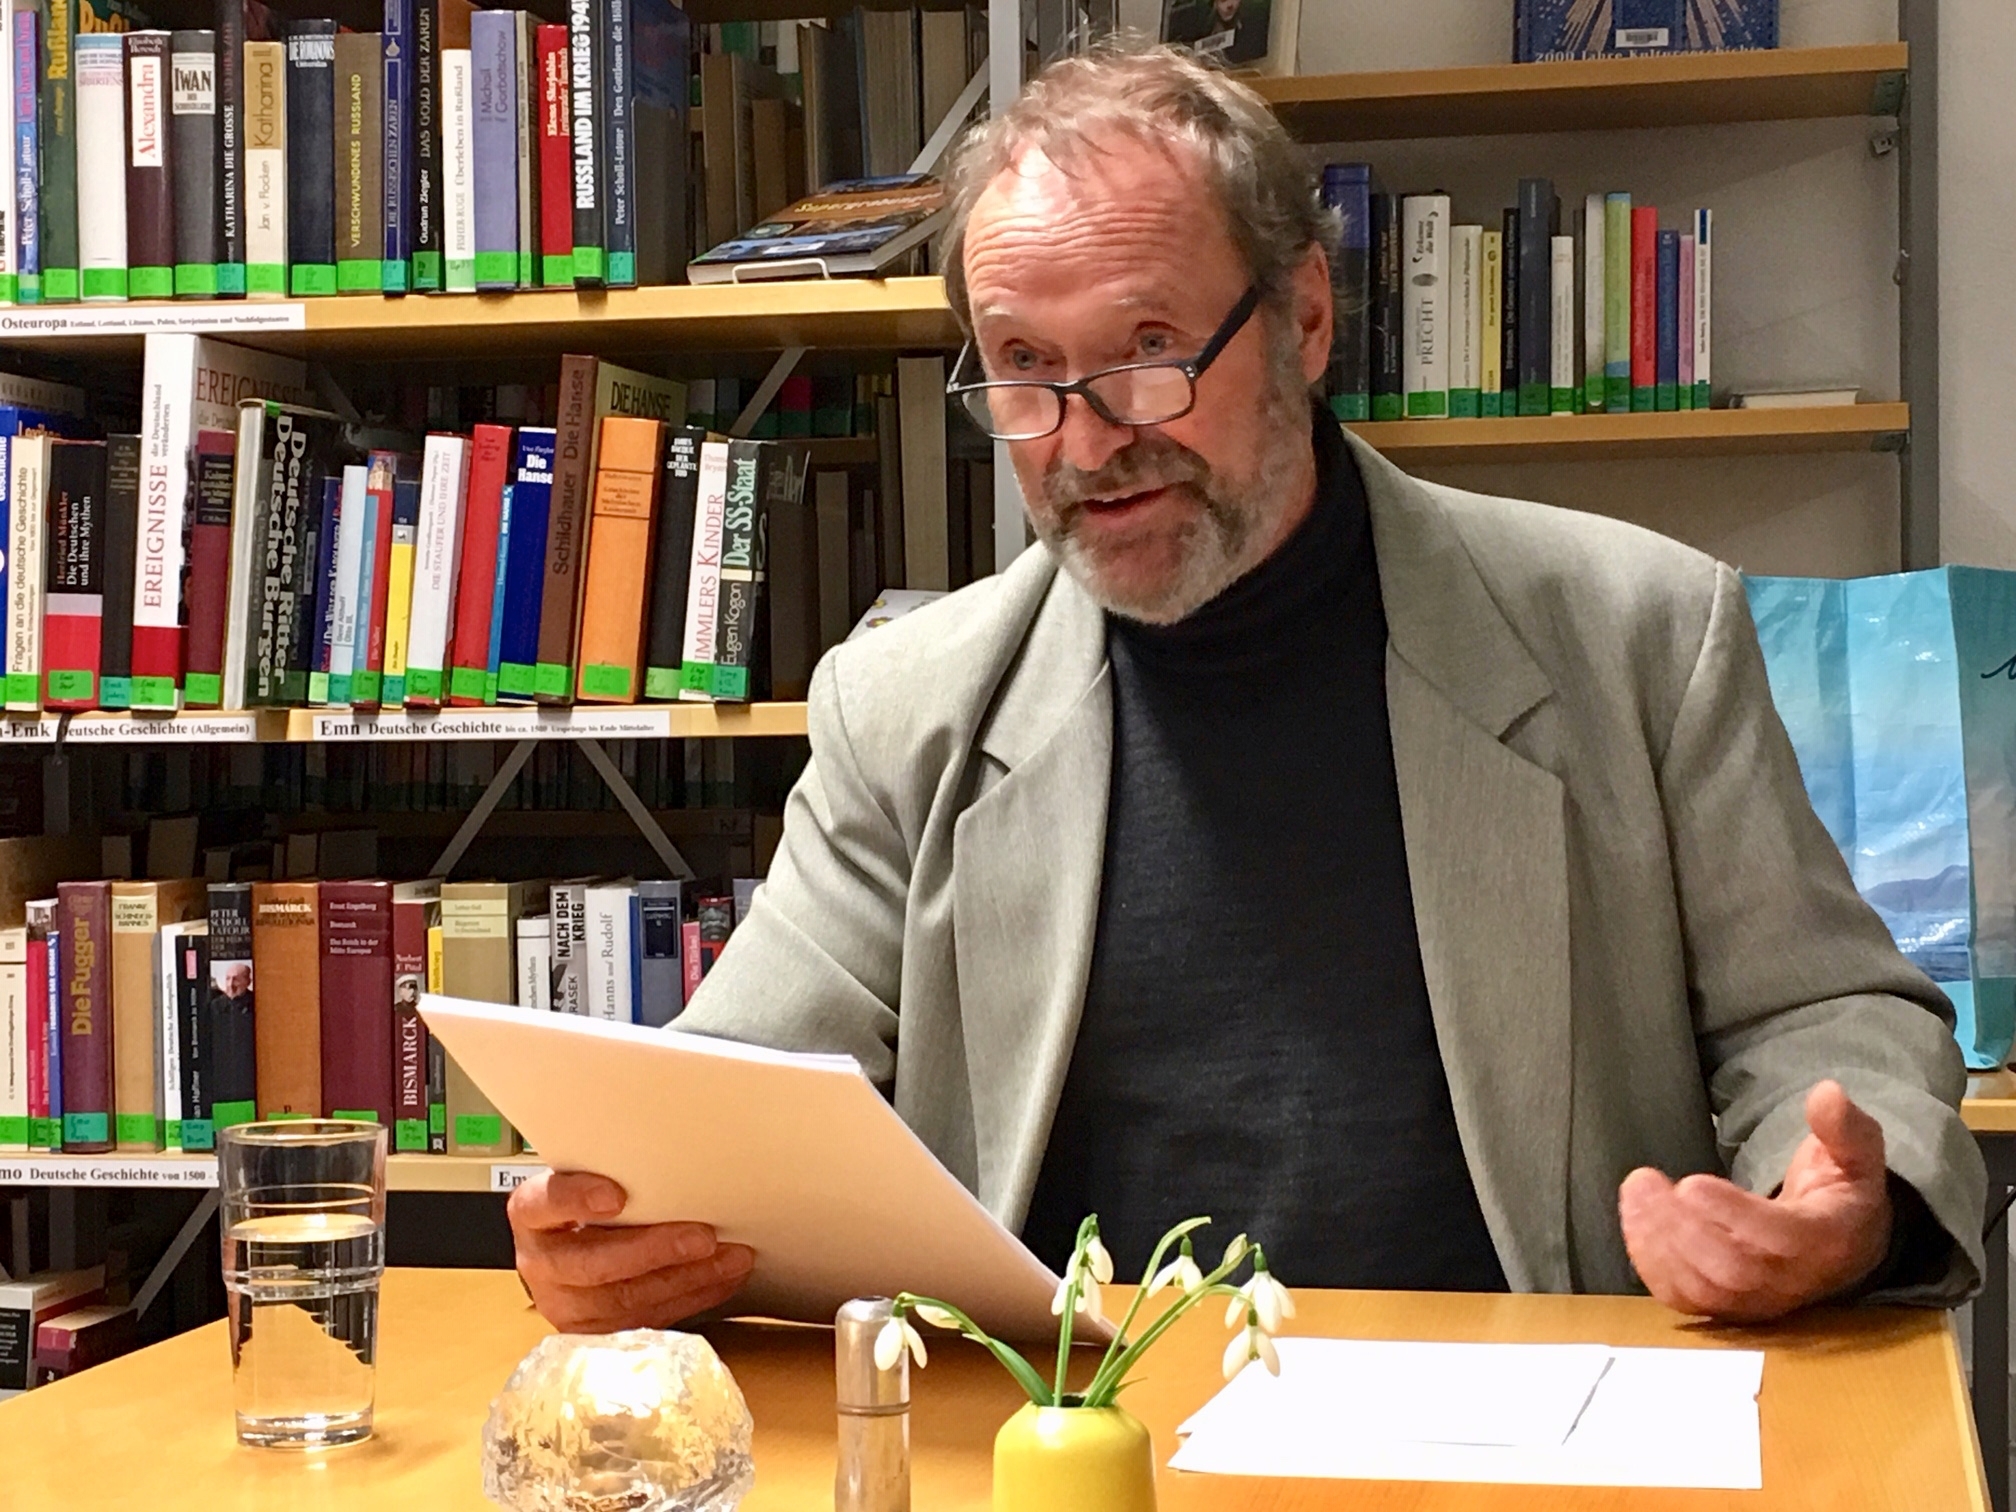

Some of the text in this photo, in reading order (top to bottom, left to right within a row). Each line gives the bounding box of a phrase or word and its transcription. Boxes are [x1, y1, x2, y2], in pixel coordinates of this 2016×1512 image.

[174, 68, 212, 92] IWAN
[419, 7, 431, 158] DAS GOLD DER ZAREN
[494, 31, 509, 114] Gorbatschow
[1535, 50, 1576, 63] 2000
[224, 105, 235, 147] GROSSE
[252, 62, 274, 147] Katharina
[454, 115, 463, 126] in
[572, 33, 595, 209] RUSSLAND IM KRIEG
[612, 25, 626, 225] Peter Scholl-Latour Den Gottlosen die
[20, 135, 33, 245] Peter Scholl-Latour
[224, 151, 235, 169] DIE
[351, 74, 362, 248] VERSCHWUNDENES RUSSLAND
[224, 172, 236, 238] KATHARINA
[257, 160, 271, 231] Jan Flocken
[418, 169, 430, 244] Gudrun Ziegler
[2, 317, 68, 331] Osteuropa
[1421, 297, 1434, 365] PRECHT
[151, 443, 160, 458] die
[441, 451, 451, 475] ZEIT
[518, 469, 554, 485] Hanse
[526, 454, 547, 469] Die
[553, 369, 584, 576] Schildhauer Die Hanse
[66, 502, 79, 586] Die Deutschen
[79, 496, 94, 586] und ihre Mythen
[143, 464, 168, 609] EREIGNISSE
[436, 501, 446, 525] UND
[696, 493, 724, 568] KINDER
[12, 466, 29, 673] Fragen an die deutsche Geschichte
[257, 415, 292, 697] Deutsche Burgen
[274, 431, 306, 685] Deutsche Ritter
[432, 573, 441, 591] DIE
[433, 527, 445, 571] STAUFER
[721, 532, 750, 567] Der
[693, 575, 716, 661] IMMLERS
[721, 582, 746, 667] Eugen Kogon
[118, 721, 188, 736] Geschichte
[191, 722, 251, 737] (Allgemein)
[320, 720, 361, 737] Emn
[368, 723, 428, 735] Deutsche
[430, 721, 502, 735] Geschichte
[258, 903, 313, 913] BISMARCK
[555, 891, 571, 958] NACH DEM
[570, 903, 585, 942] KRIEG
[599, 912, 614, 958] Rudolf
[70, 917, 95, 1036] Die Fugger
[602, 979, 615, 1021] Hanns
[402, 1016, 418, 1106] BISMARCK
[29, 1168, 87, 1181] Deutsche
[89, 1168, 160, 1181] Geschichte
[162, 1172, 180, 1181] von
[182, 1170, 206, 1181] 1500
